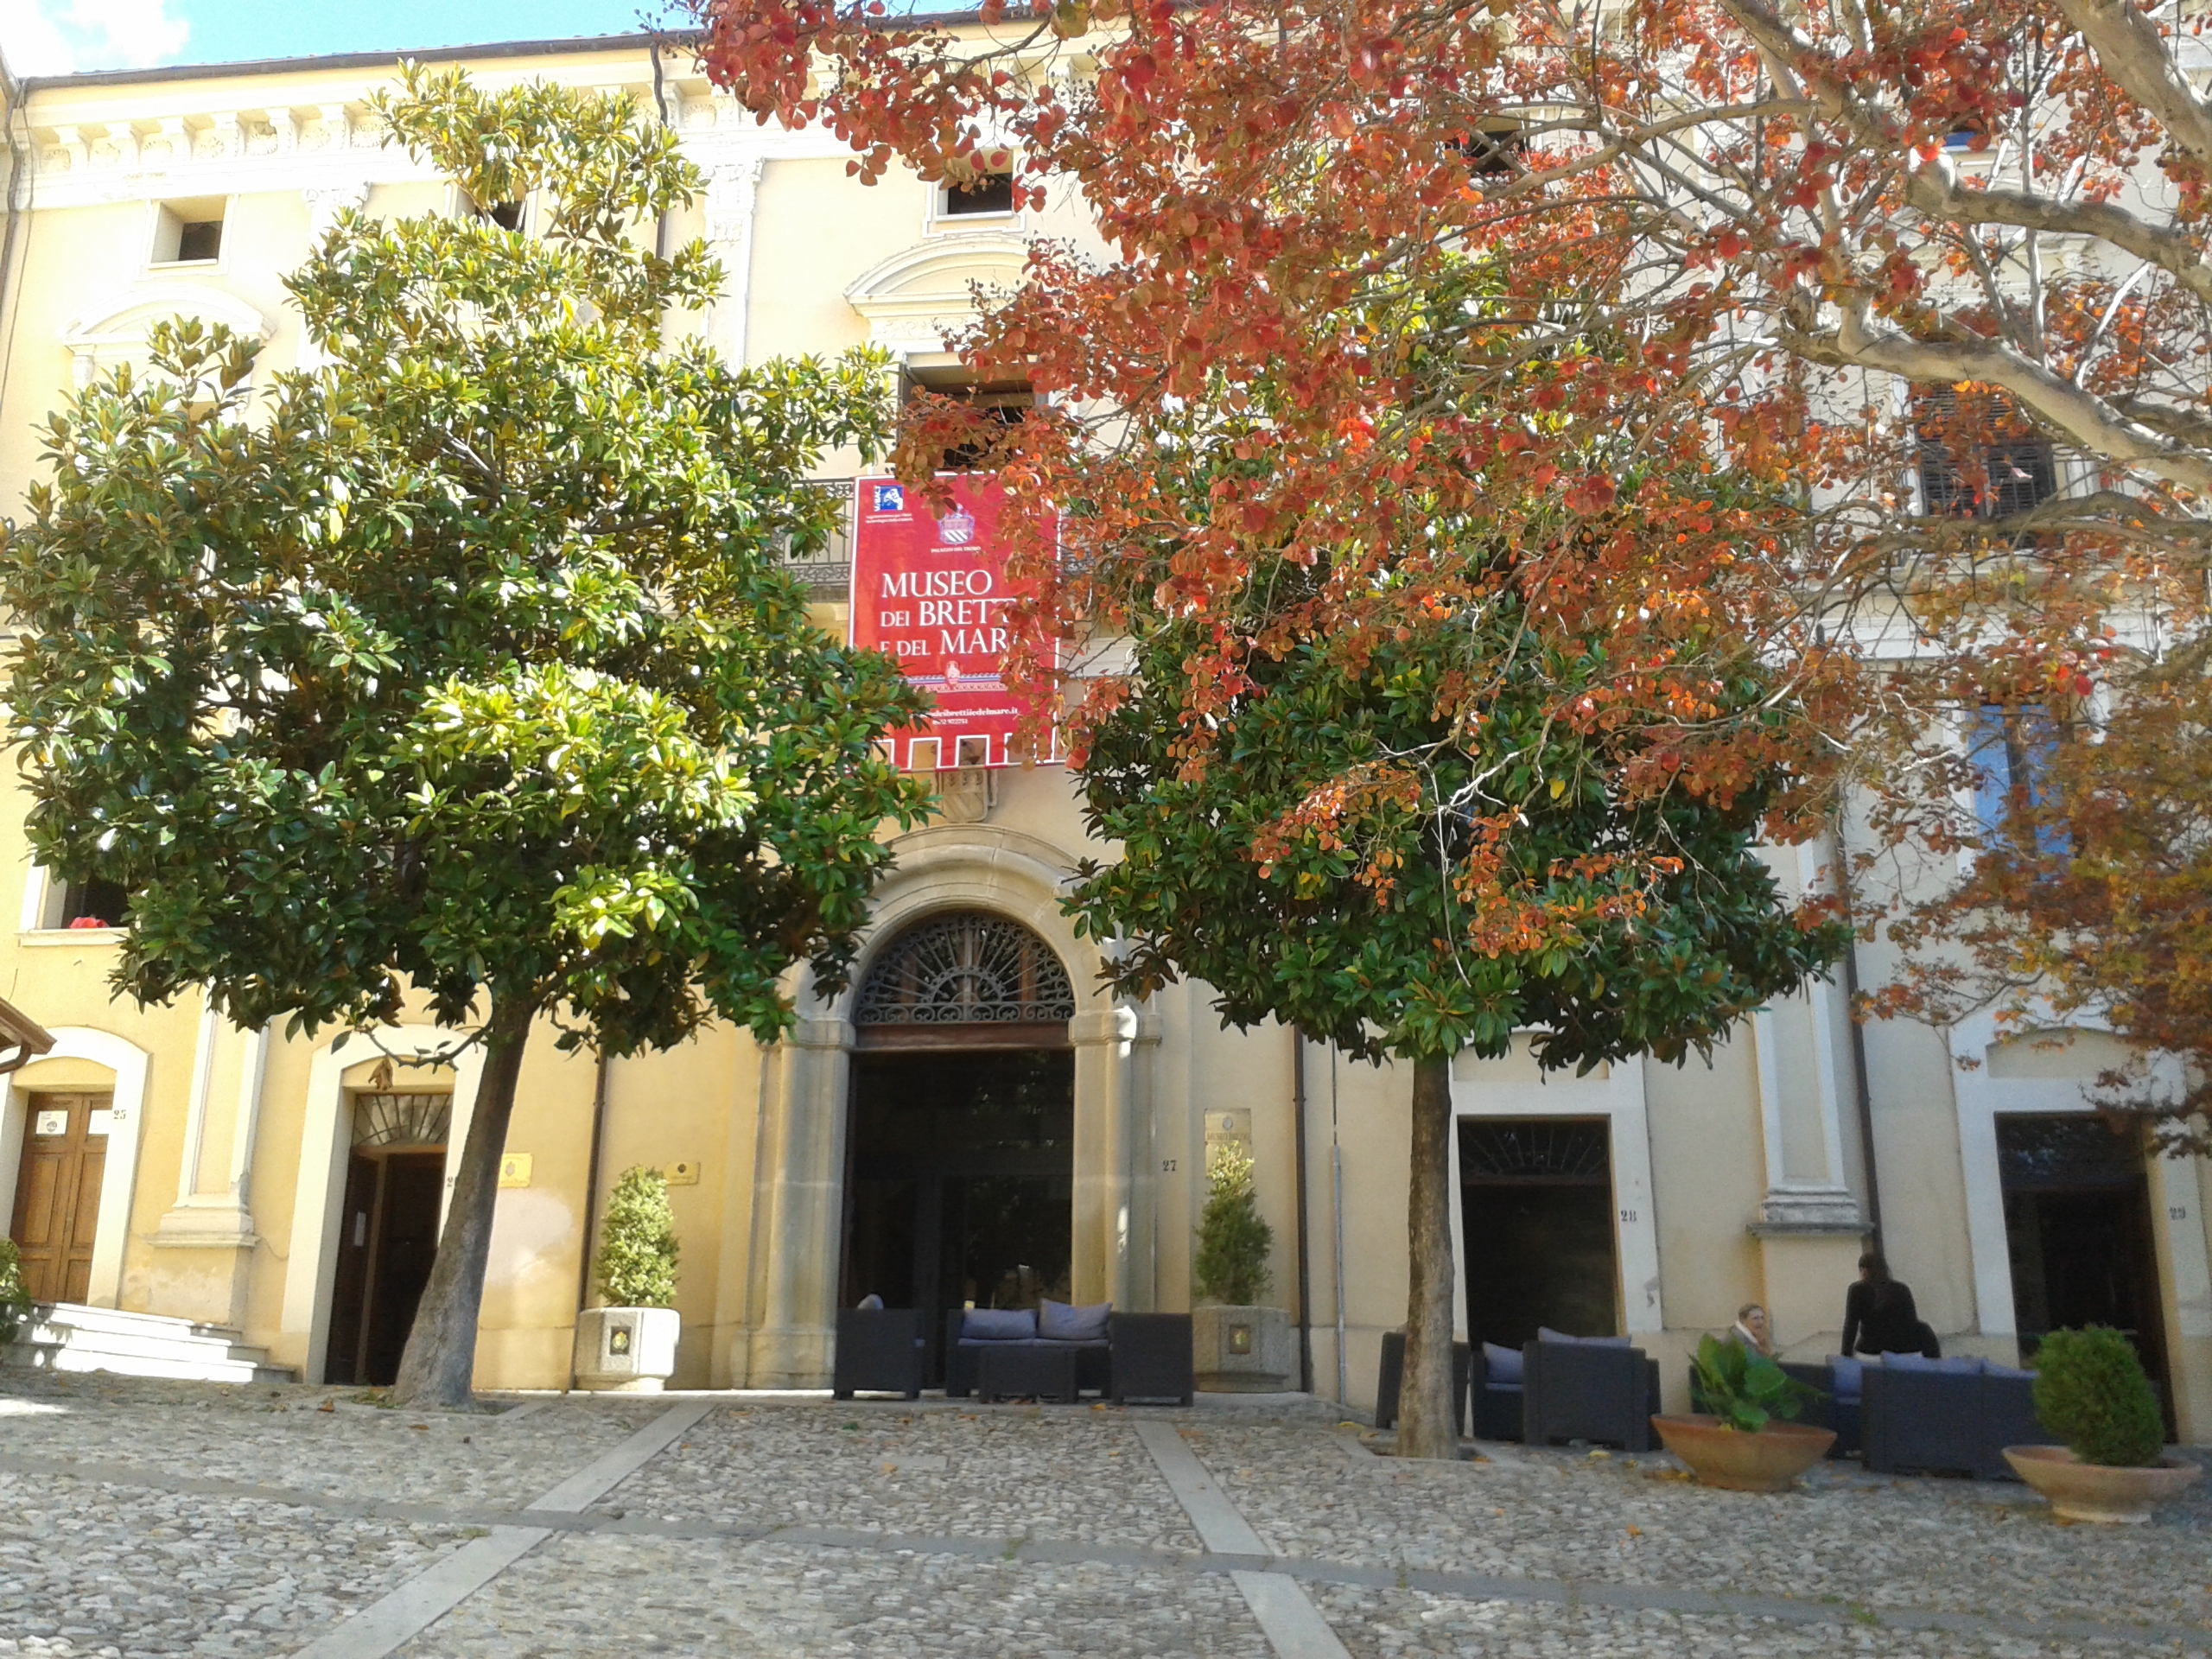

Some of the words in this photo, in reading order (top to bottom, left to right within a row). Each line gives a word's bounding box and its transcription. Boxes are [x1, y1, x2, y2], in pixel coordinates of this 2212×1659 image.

[881, 569, 992, 598] MUSEO
[880, 610, 910, 627] DEI
[918, 597, 1033, 626] BRETT
[896, 639, 931, 657] DEL
[938, 627, 1020, 655] MAR
[113, 1109, 126, 1120] 25
[1162, 1160, 1178, 1172] 27
[447, 1176, 454, 1187] 2
[1620, 1210, 1637, 1222] 28
